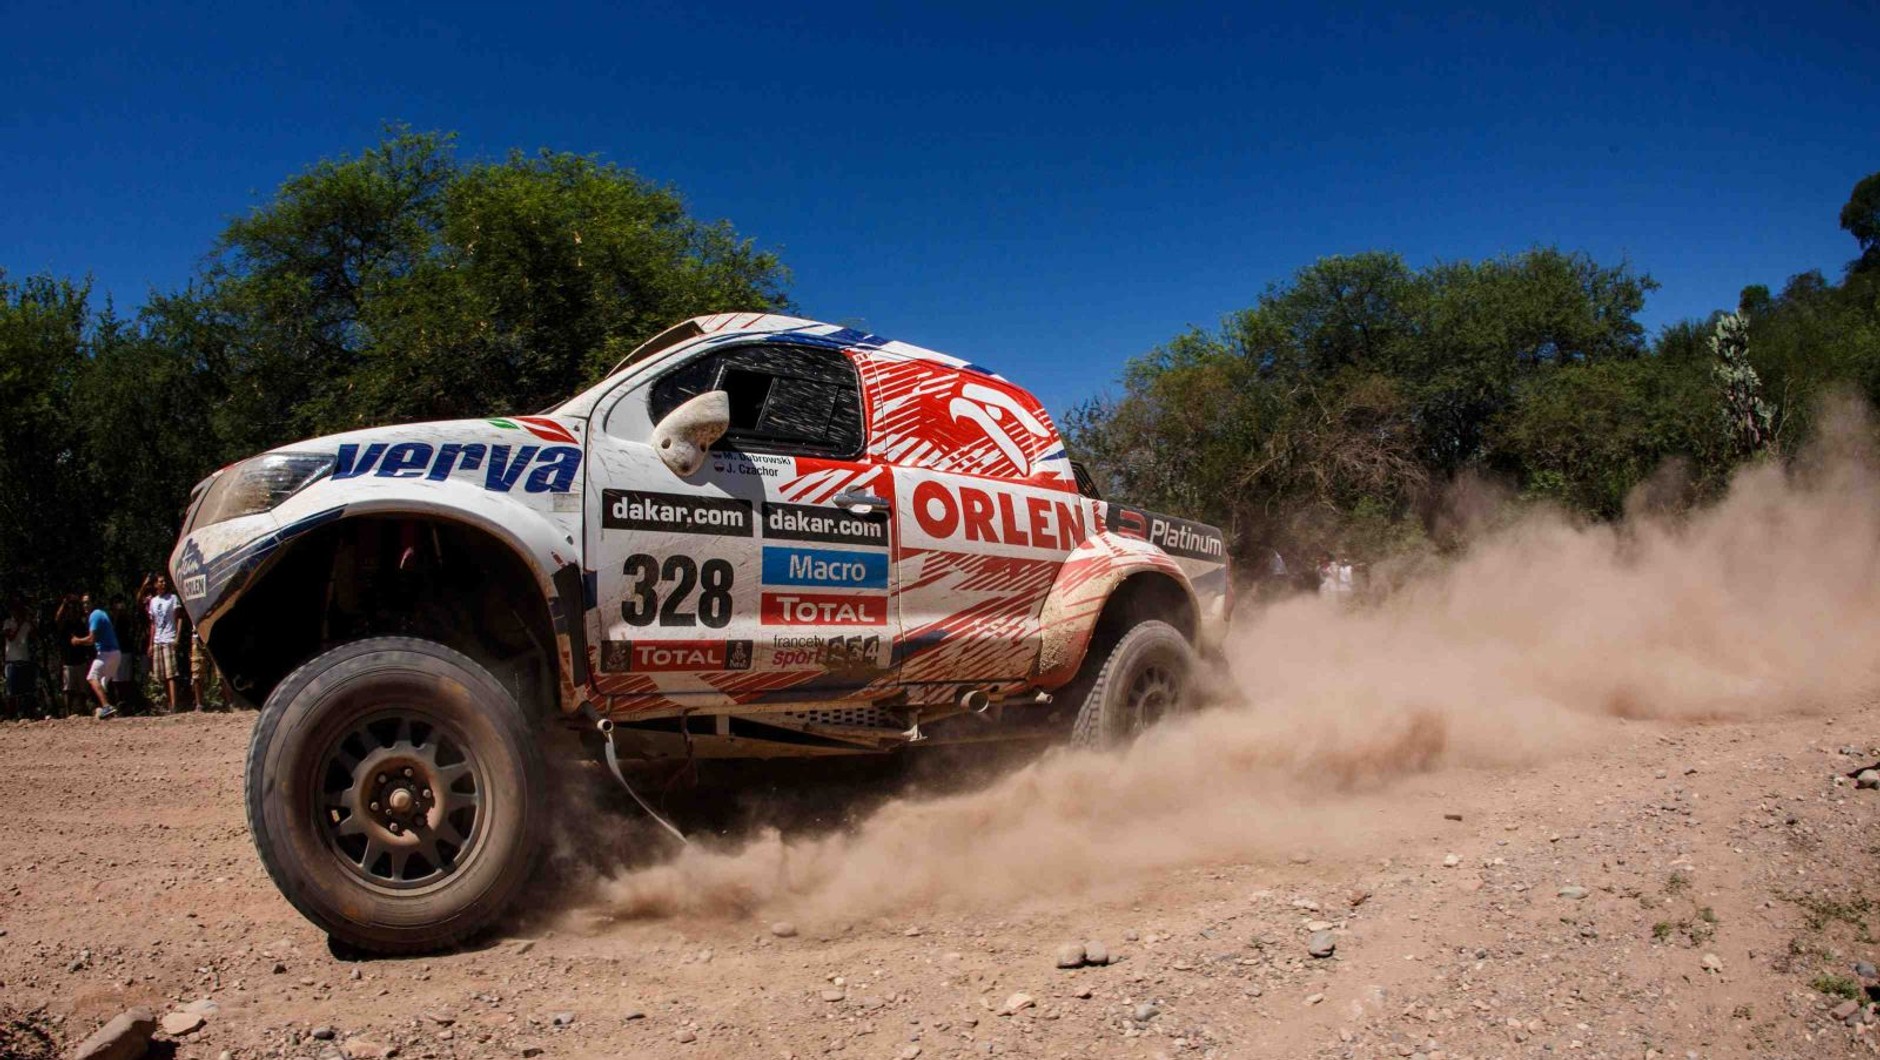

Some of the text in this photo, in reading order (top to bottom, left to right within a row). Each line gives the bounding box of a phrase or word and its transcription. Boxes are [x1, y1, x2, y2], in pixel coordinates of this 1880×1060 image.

[331, 442, 583, 494] verva
[727, 462, 779, 477] J. Czachor
[613, 497, 744, 527] dakar.com
[769, 510, 882, 538] dakar.com
[912, 480, 1086, 551] ORLEN
[1149, 516, 1222, 557] Platinum
[789, 554, 867, 582] Macro
[621, 553, 735, 629] 328
[776, 596, 876, 623] TOTAL
[636, 645, 722, 666] TOTAL
